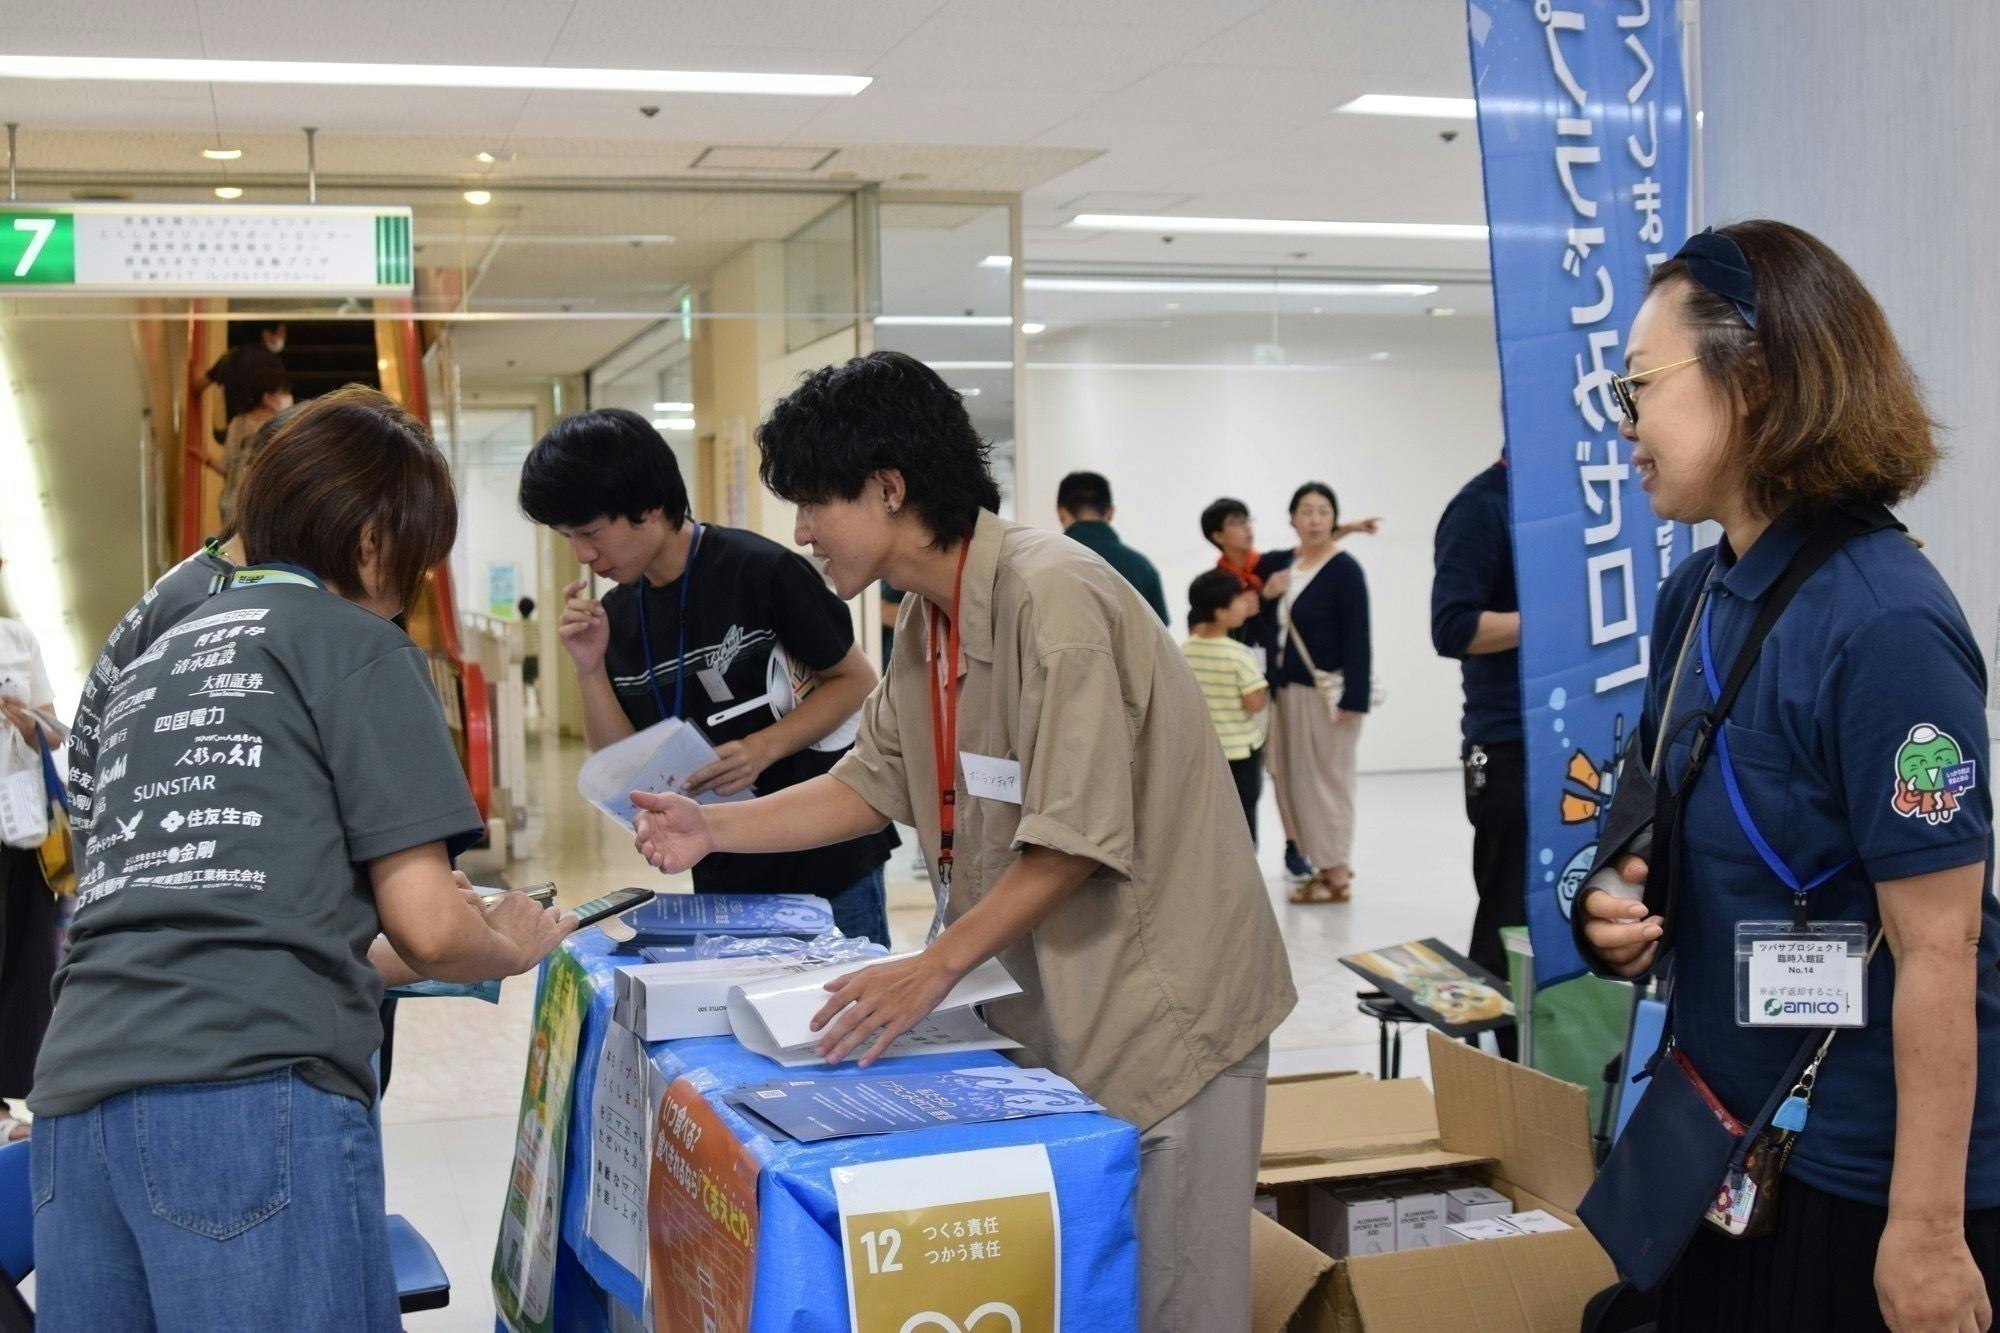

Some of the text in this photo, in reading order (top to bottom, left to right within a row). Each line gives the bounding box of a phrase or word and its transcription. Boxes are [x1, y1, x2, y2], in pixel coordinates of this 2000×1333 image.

[14, 219, 56, 277] 7
[170, 648, 237, 676] 清水建設
[199, 672, 264, 692] 大和証券
[153, 705, 225, 733] 四国電力
[133, 775, 216, 803] SUNSTAR
[186, 806, 263, 828] 住友生命
[1759, 943, 1842, 953] ツバサプロジェクト
[1777, 954, 1824, 963] 臨時入館証
[1783, 1001, 1839, 1014] amico
[922, 1216, 1000, 1241] つくる責任
[860, 1228, 904, 1275] 12
[924, 1240, 1001, 1265] つかう責任
